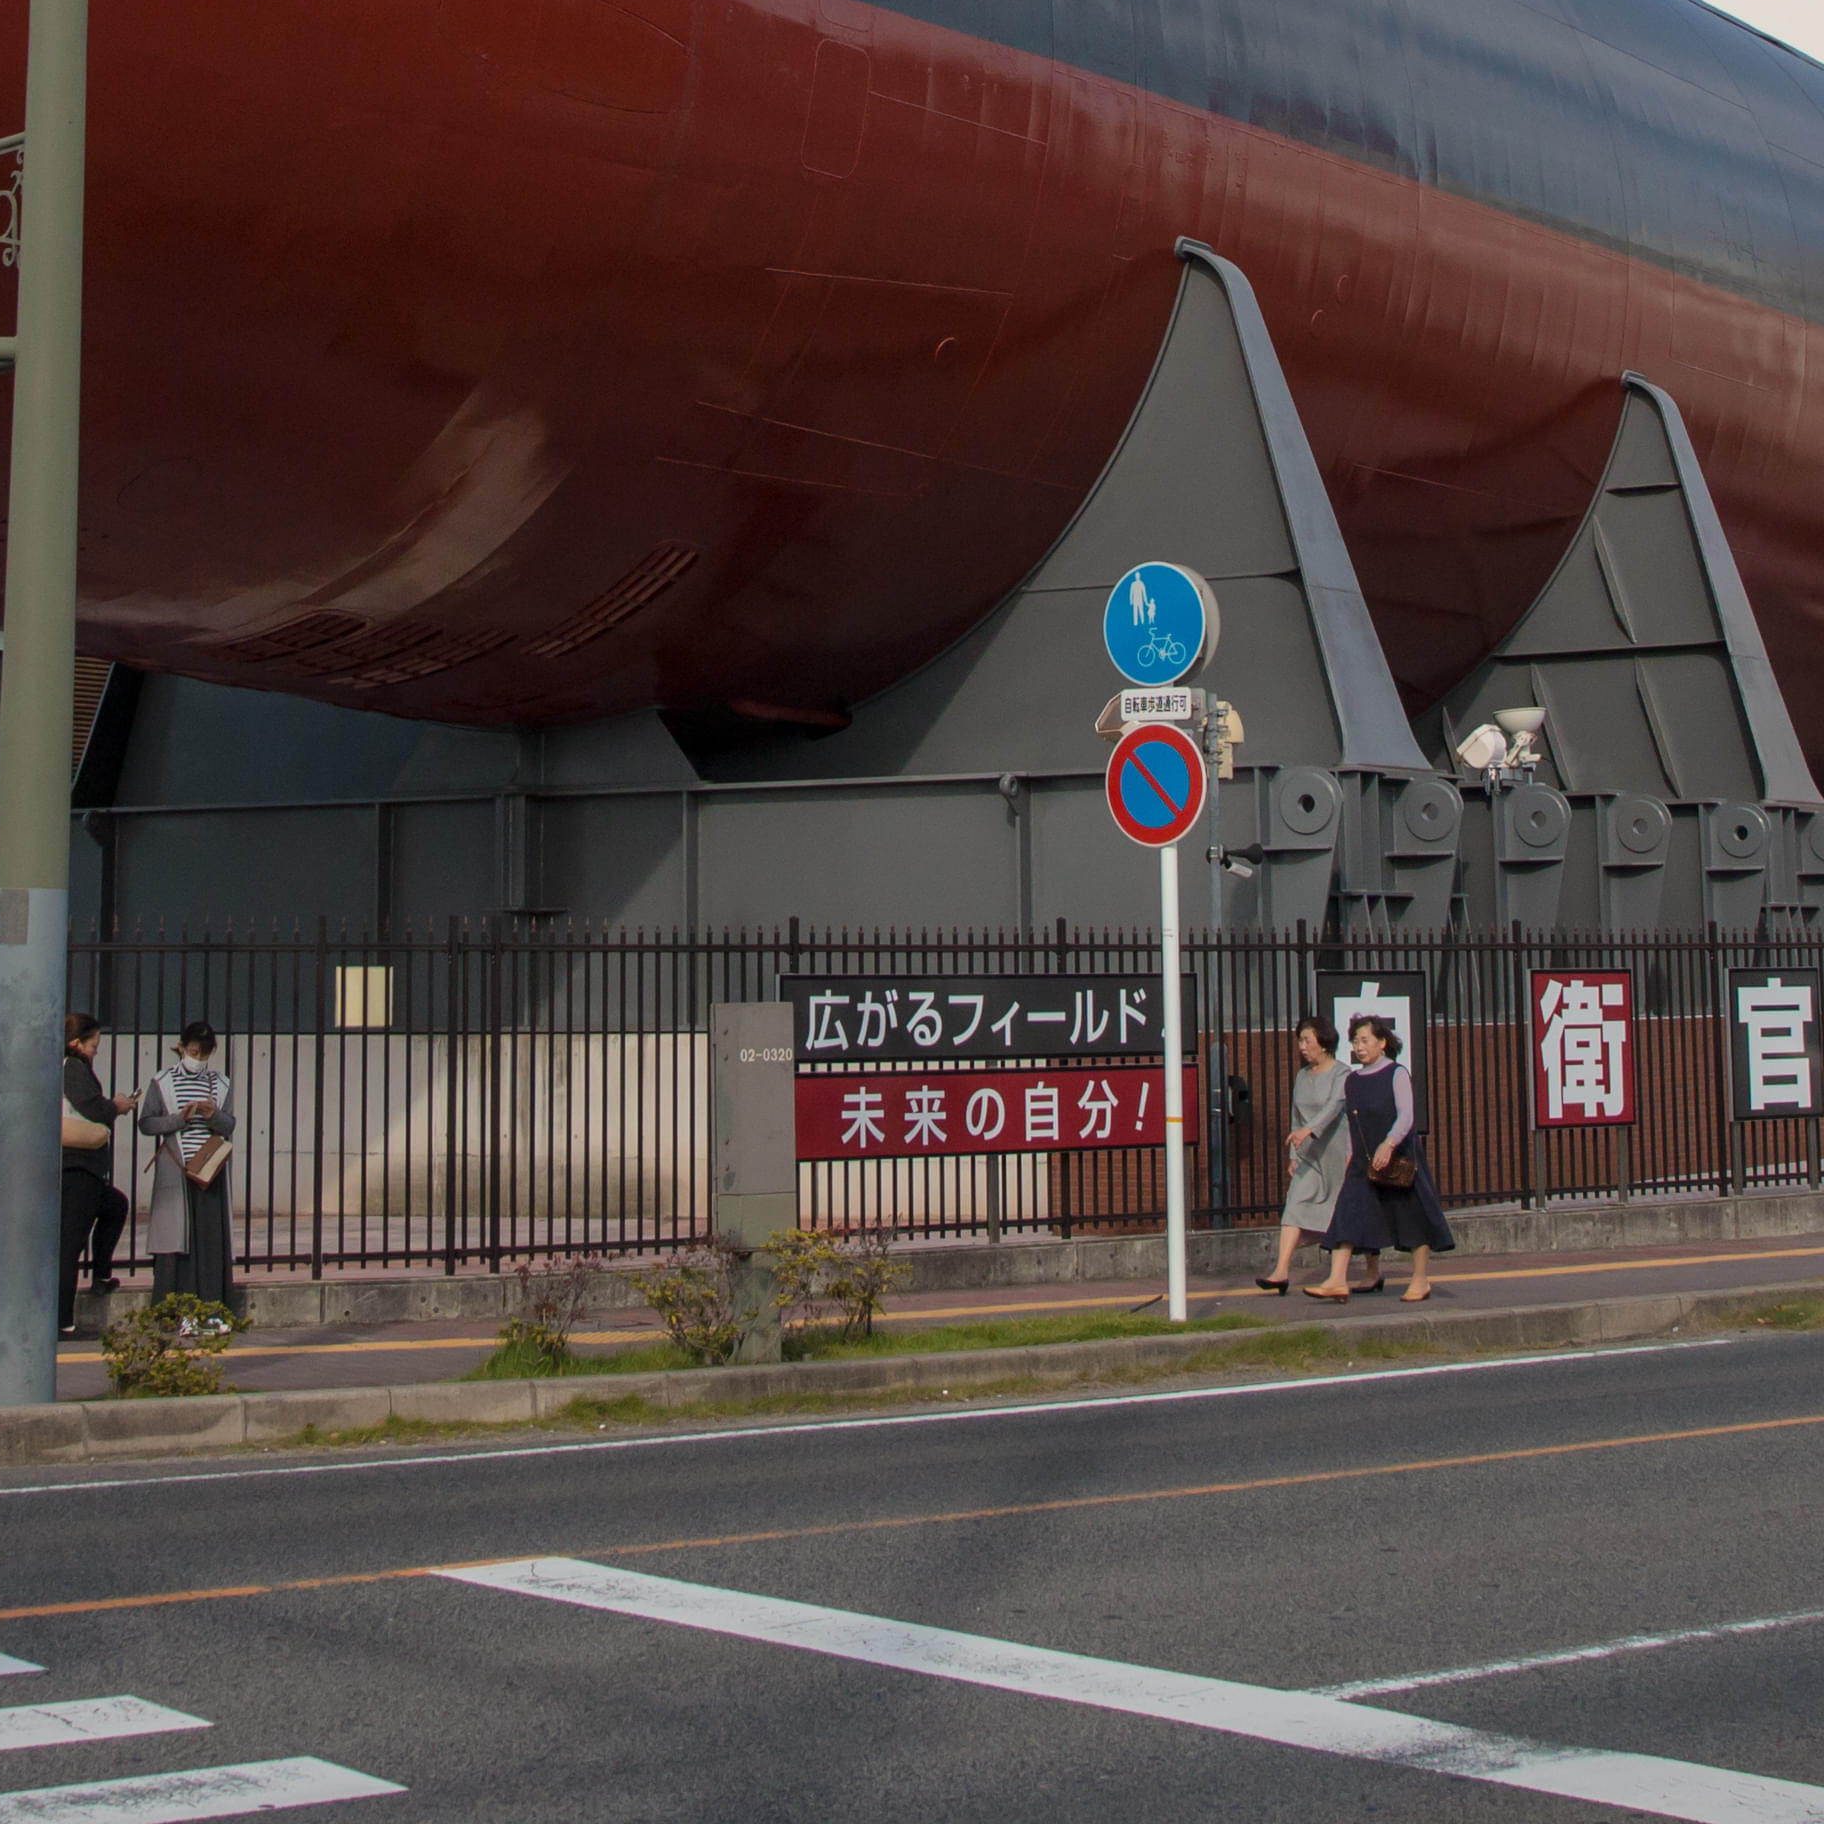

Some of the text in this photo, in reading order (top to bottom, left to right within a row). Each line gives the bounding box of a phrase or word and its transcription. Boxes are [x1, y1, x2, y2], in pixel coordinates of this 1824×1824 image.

[806, 988, 1165, 1052] 広がるフィールド
[740, 1047, 793, 1062] 02-0320
[841, 1079, 1150, 1148] 未来の自分！
